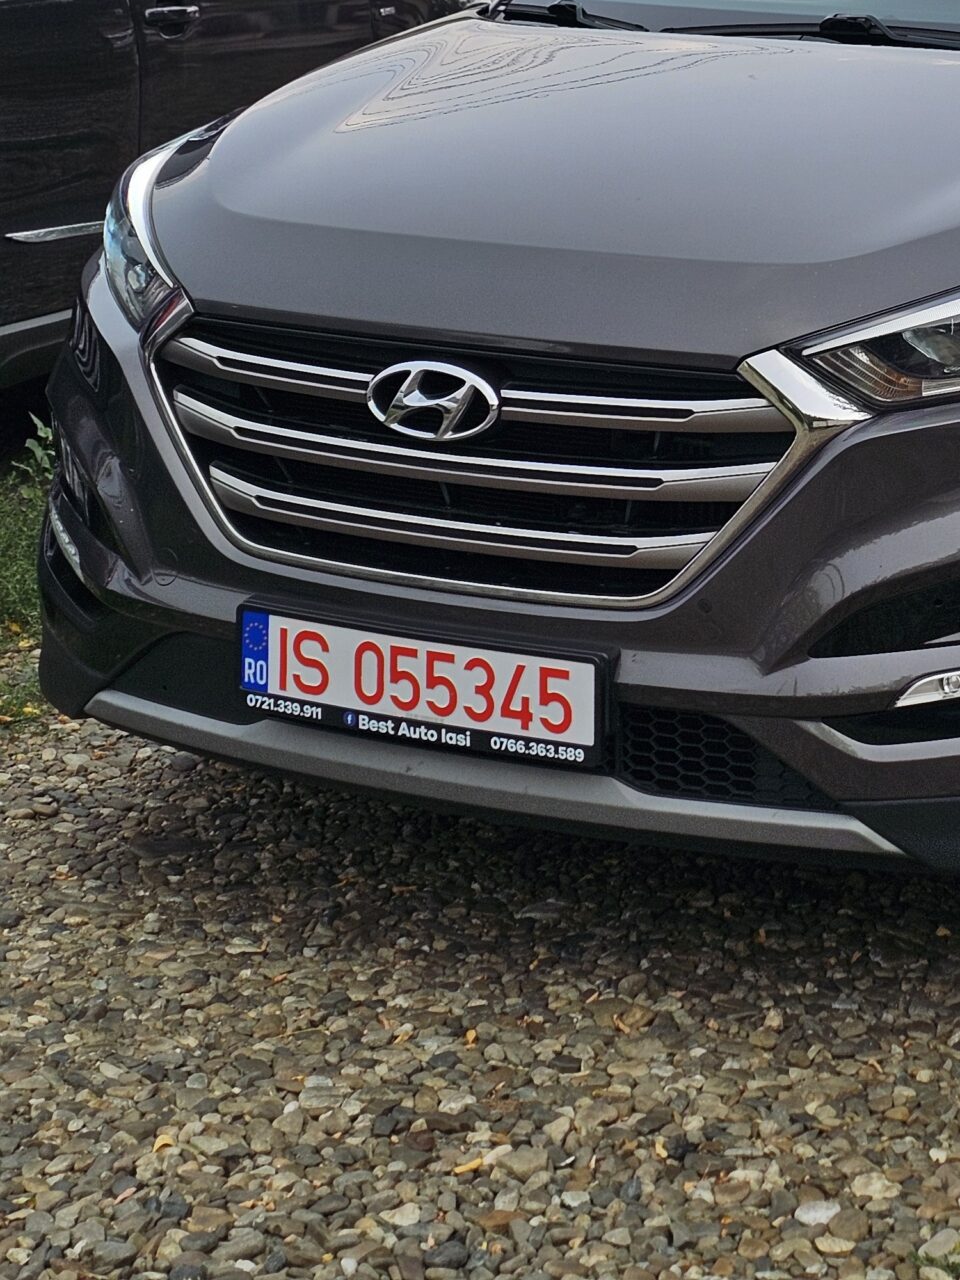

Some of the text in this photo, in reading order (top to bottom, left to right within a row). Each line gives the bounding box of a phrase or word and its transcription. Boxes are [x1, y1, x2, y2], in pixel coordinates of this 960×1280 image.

[244, 657, 267, 685] RO
[279, 627, 573, 735] IS 055345
[246, 693, 322, 720] 0721.339.911
[358, 714, 395, 736] Best
[398, 721, 438, 742] Auto
[441, 728, 471, 747] Iasi
[490, 736, 585, 762] 0766.363.589
